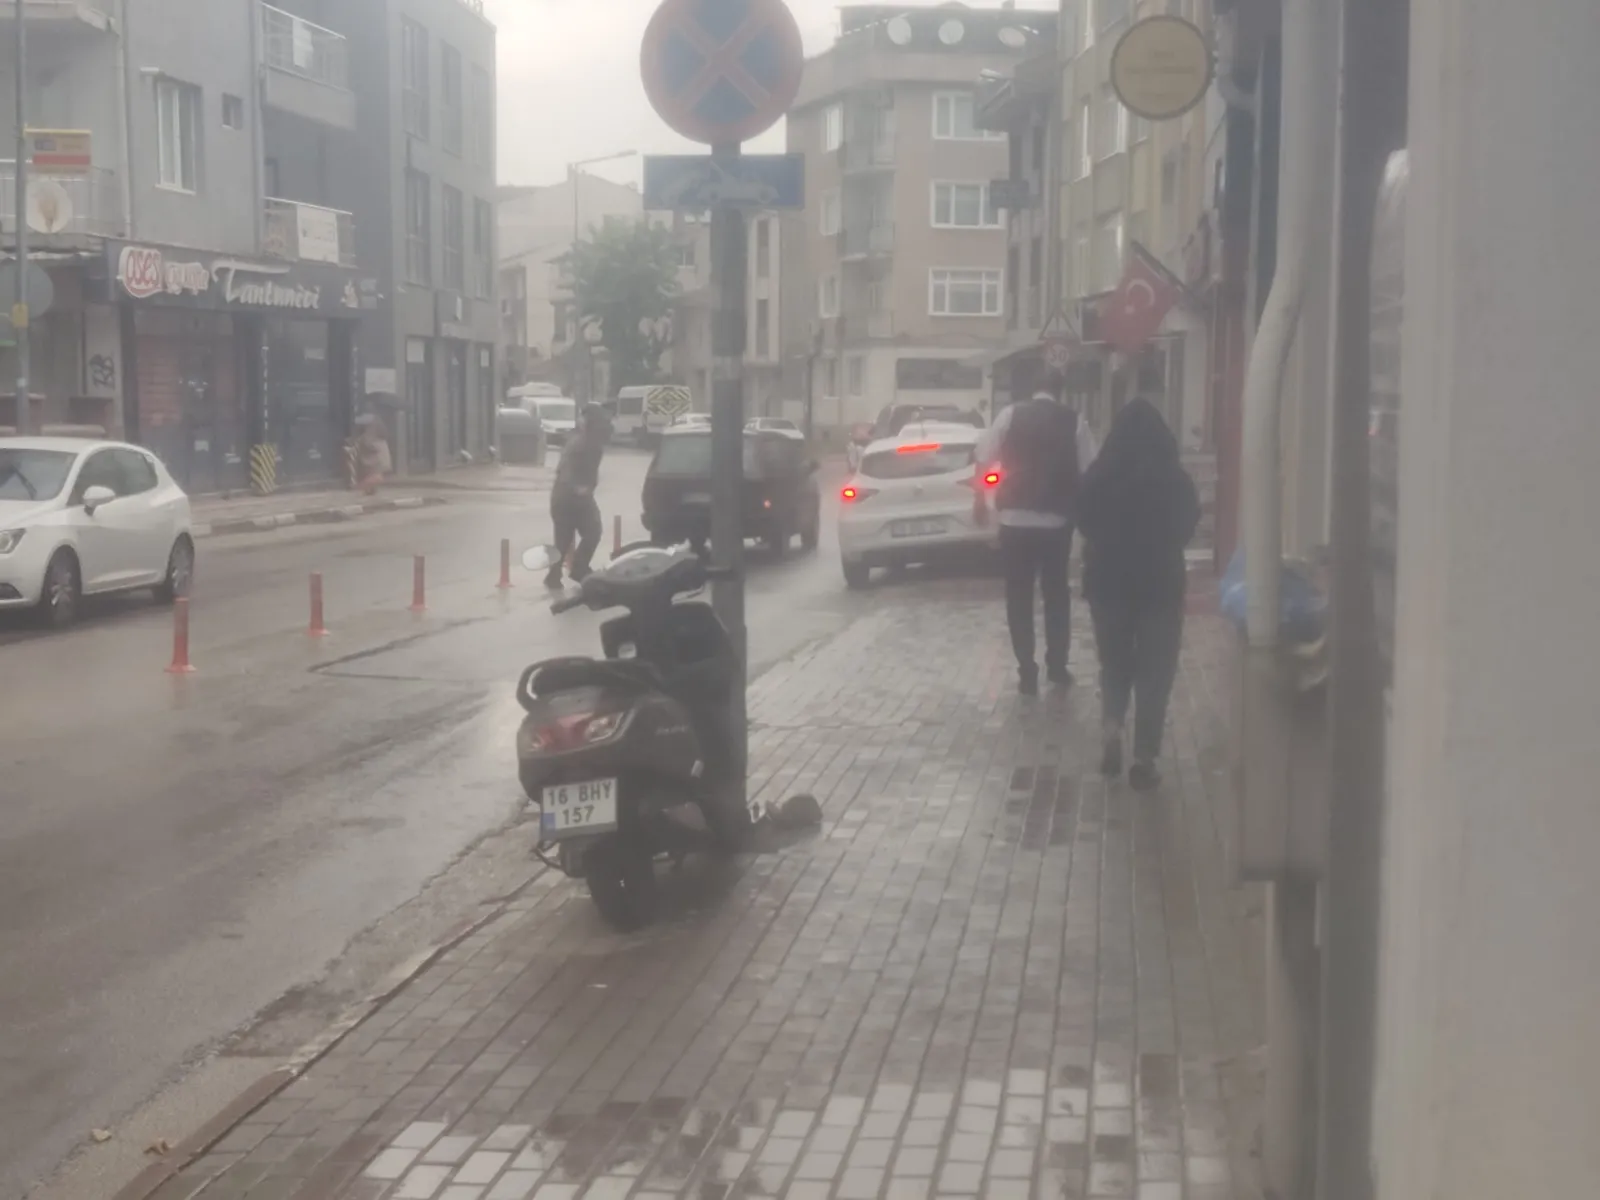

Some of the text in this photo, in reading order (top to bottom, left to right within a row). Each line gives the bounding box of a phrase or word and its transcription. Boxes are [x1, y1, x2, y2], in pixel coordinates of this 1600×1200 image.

[548, 780, 613, 807] 16 BHY
[562, 804, 595, 825] 157
